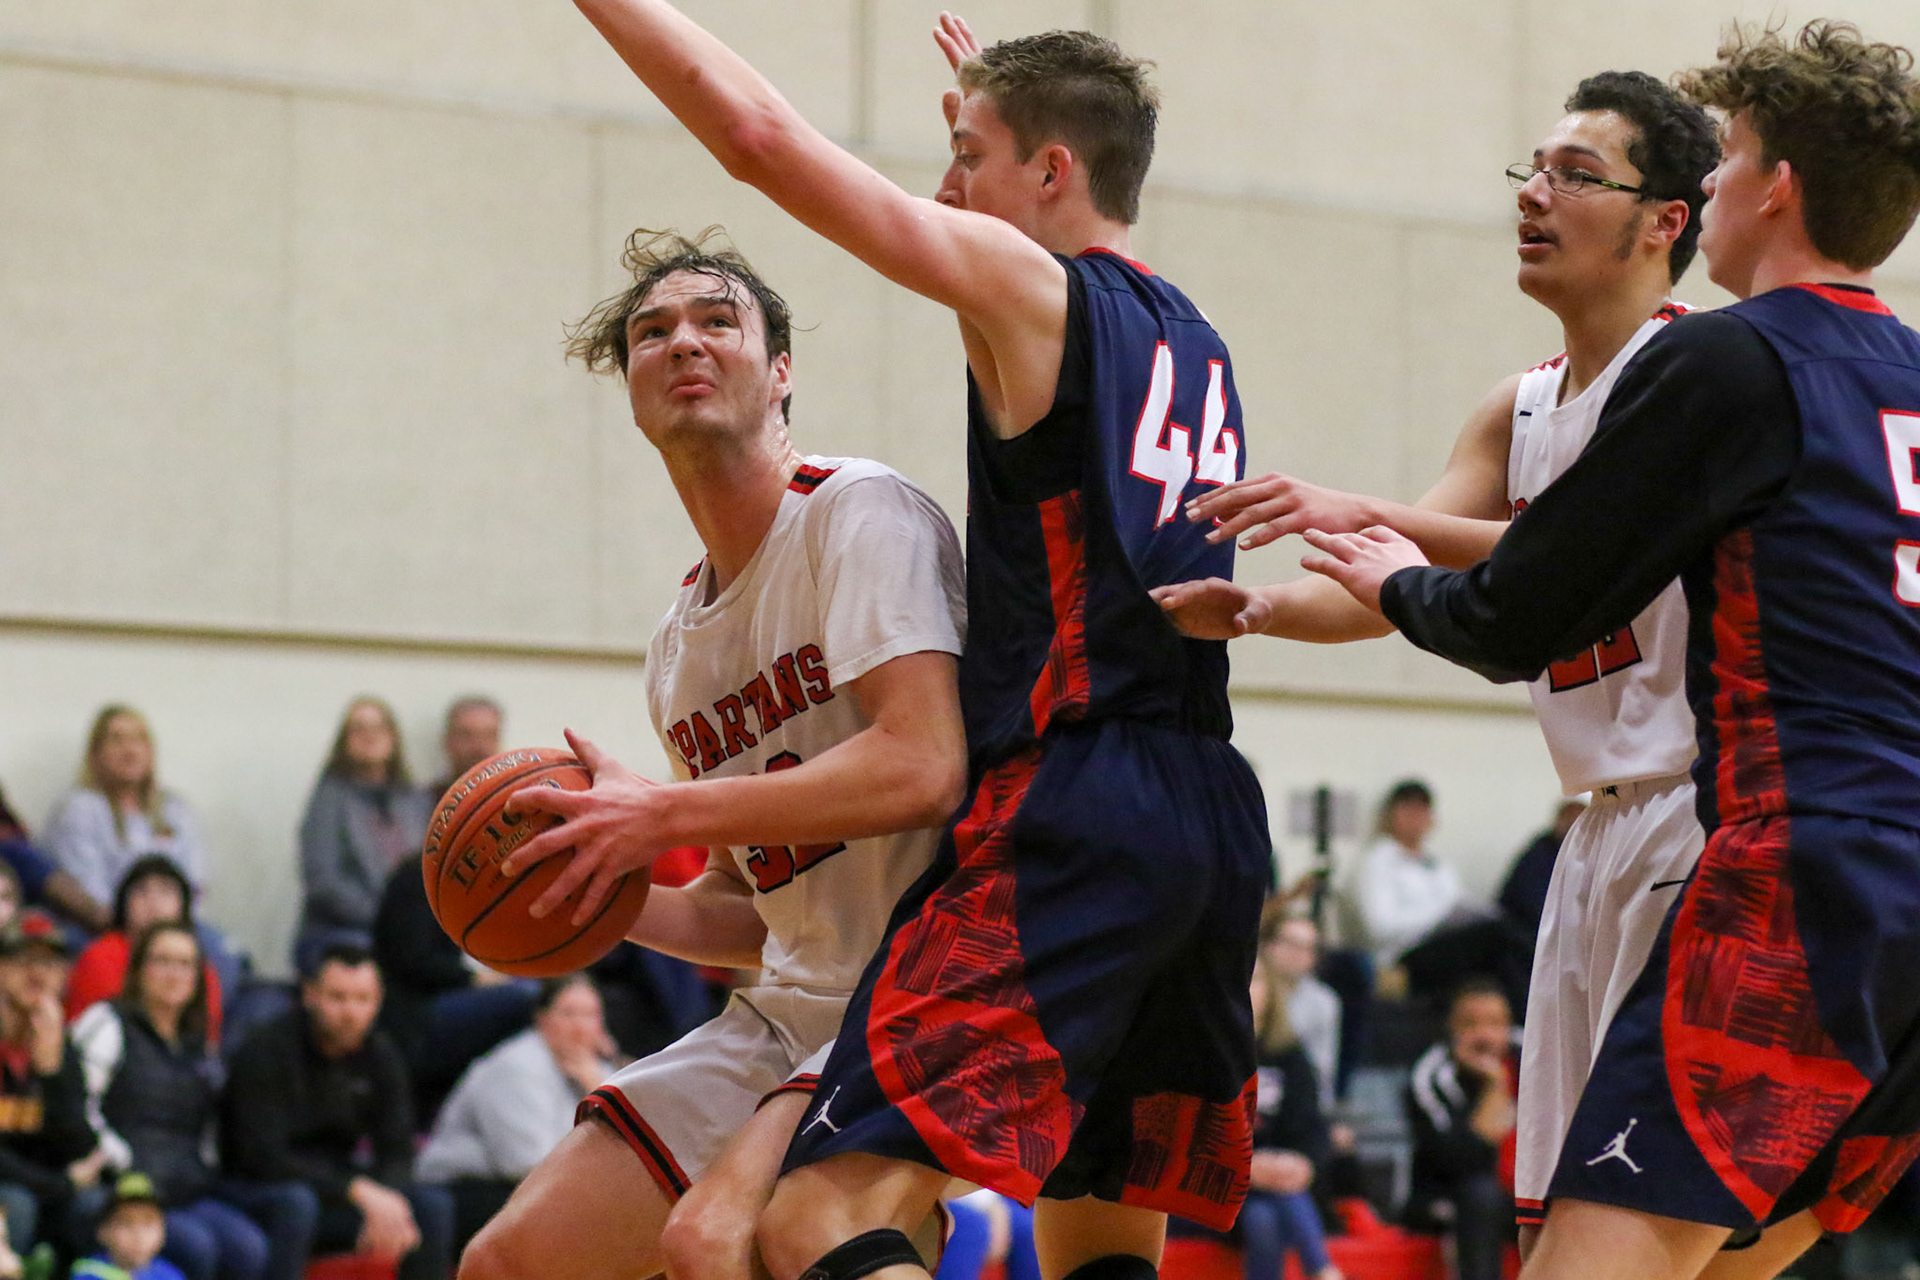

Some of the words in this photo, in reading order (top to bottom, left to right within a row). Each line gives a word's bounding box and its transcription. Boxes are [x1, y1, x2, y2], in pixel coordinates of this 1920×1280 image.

[1129, 340, 1239, 530] 44
[667, 643, 835, 780] PARTANS
[425, 752, 542, 856] SPALDING
[489, 818, 534, 865] LEGACY
